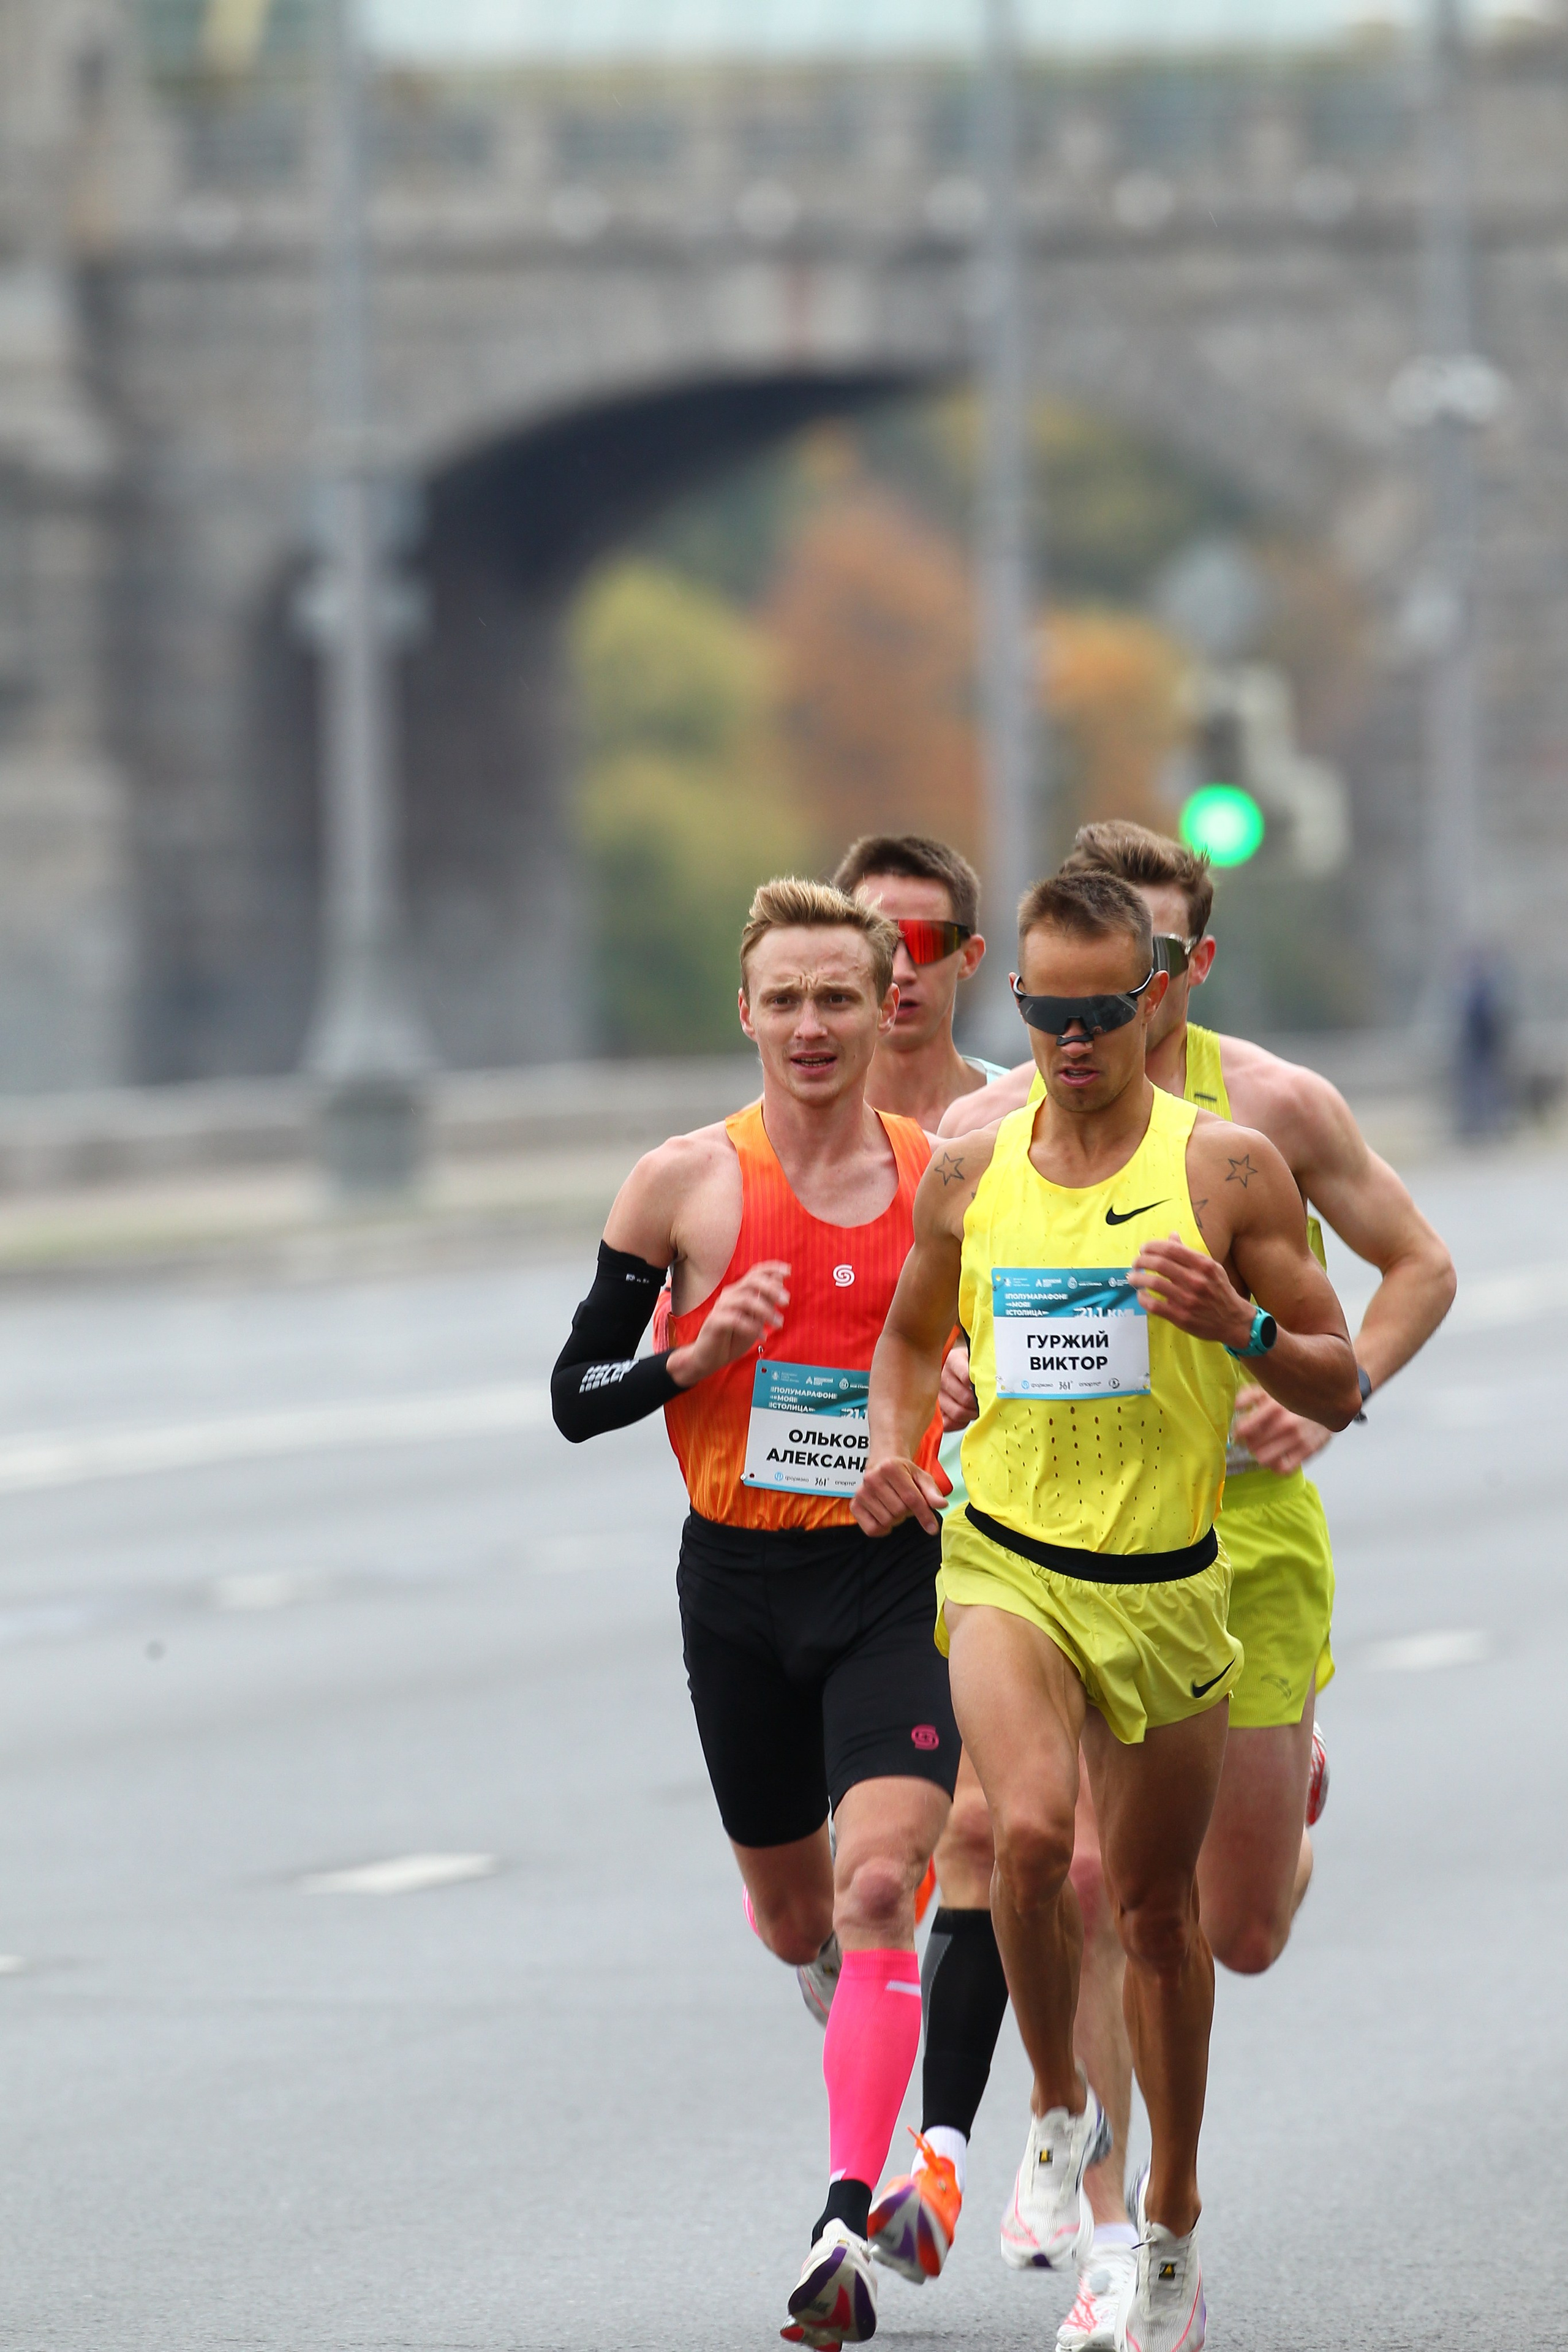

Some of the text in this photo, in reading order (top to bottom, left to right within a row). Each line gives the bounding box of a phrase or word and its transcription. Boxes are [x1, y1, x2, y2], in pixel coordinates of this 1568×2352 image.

[1027, 1330, 1109, 1348] ГУРЖИЙ
[1030, 1357, 1108, 1370] ВИКТОР
[774, 1387, 835, 1400] ПОЛУМАРАФОН
[789, 1430, 869, 1449] ОЛЬКОВ
